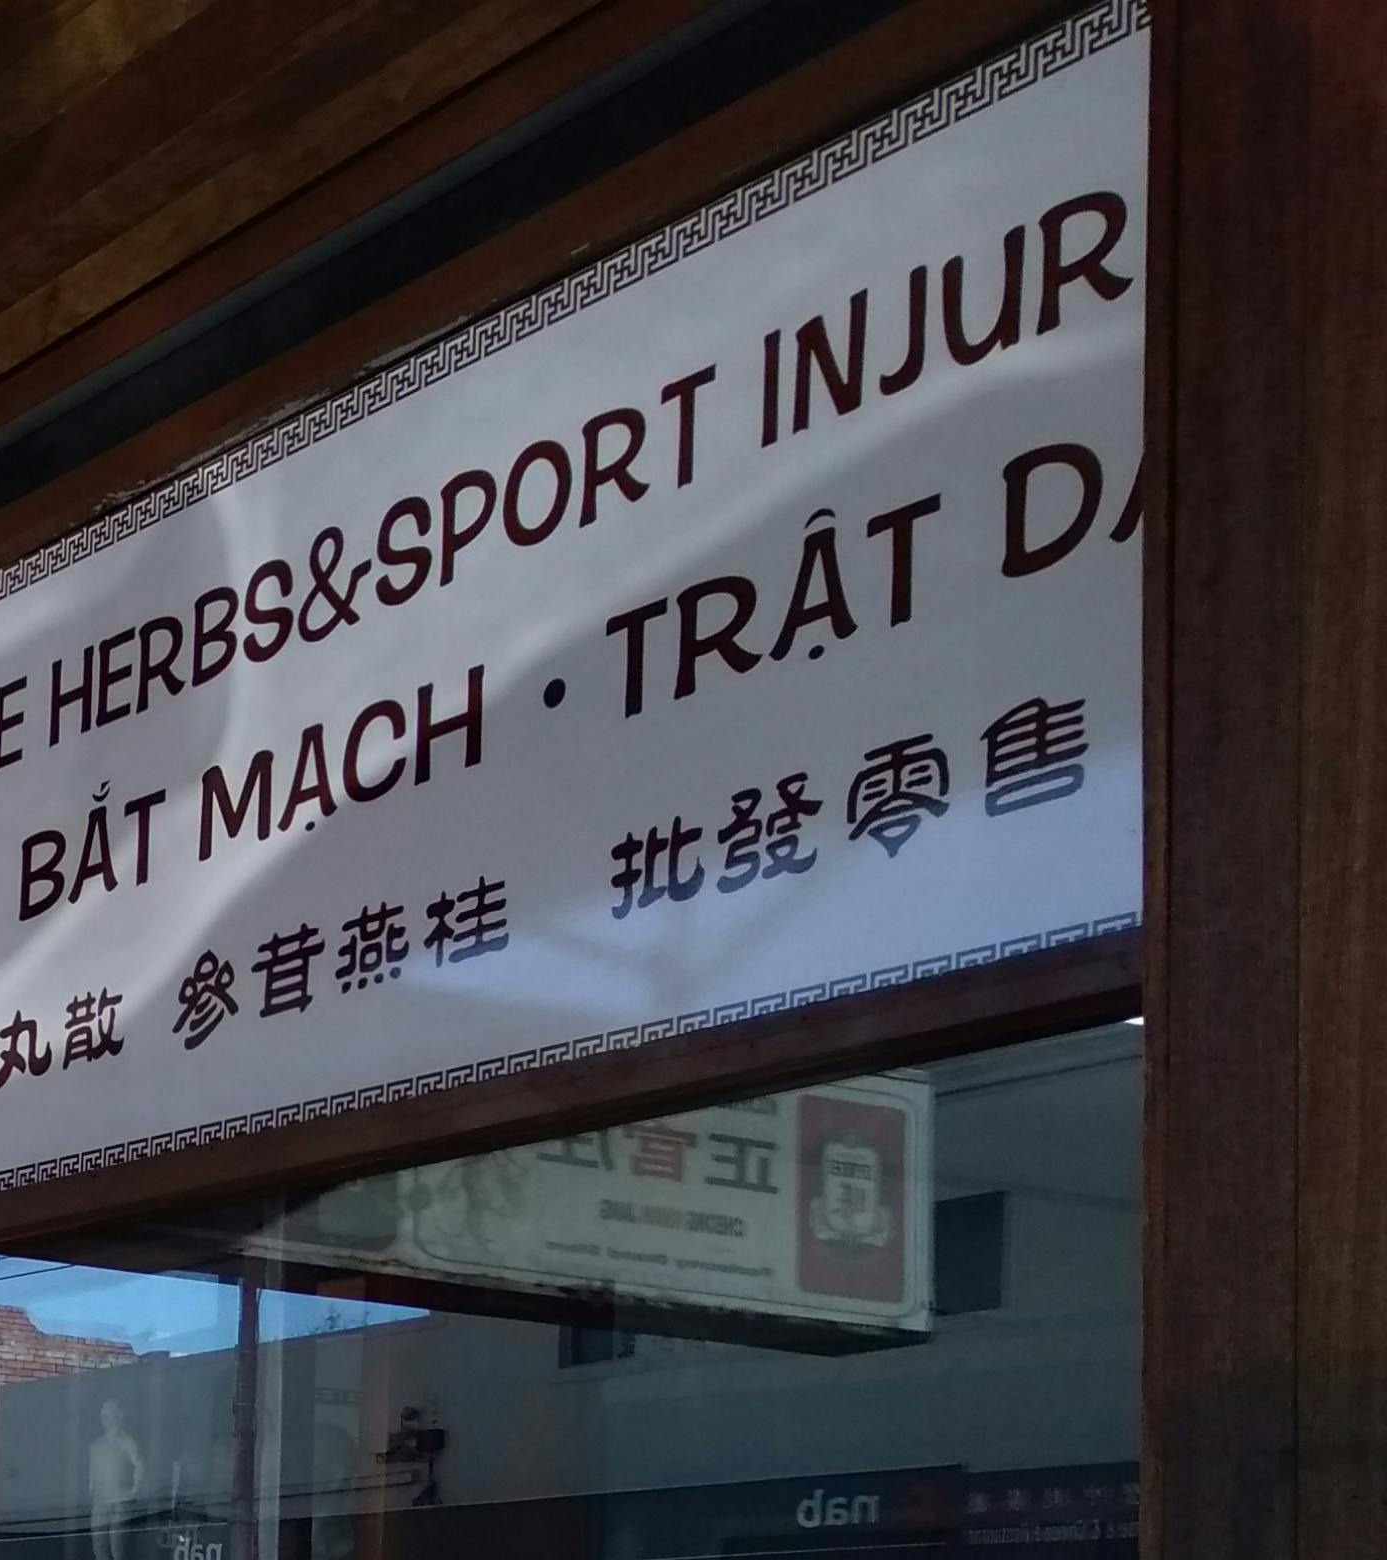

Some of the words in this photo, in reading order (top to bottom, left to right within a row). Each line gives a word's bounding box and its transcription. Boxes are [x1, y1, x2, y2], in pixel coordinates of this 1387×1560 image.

[759, 189, 1135, 449] INJUR
[197, 664, 488, 863] MẠCH
[605, 495, 942, 720] TRẬT
[609, 697, 1090, 920] 批發零售
